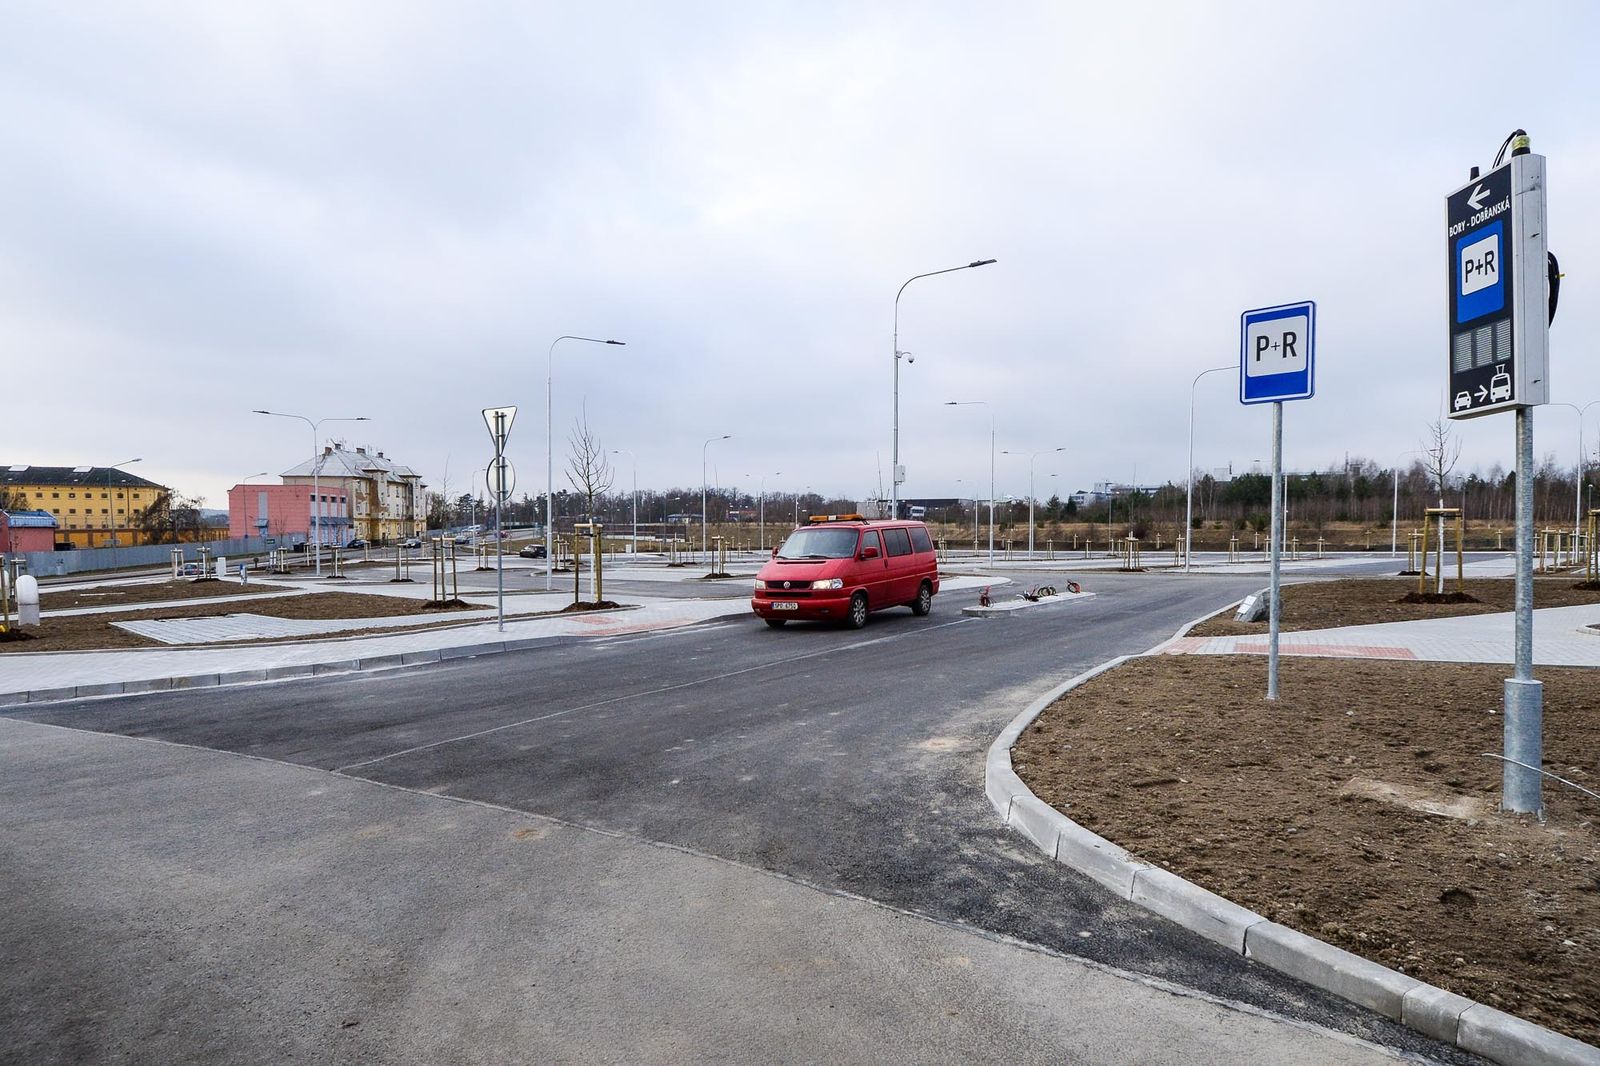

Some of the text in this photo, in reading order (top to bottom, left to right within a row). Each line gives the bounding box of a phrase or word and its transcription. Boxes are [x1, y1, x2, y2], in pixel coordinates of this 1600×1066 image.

[1449, 220, 1465, 237] BORY
[1471, 195, 1510, 227] DOBŘANSKÁ
[1465, 250, 1495, 283] P+R
[1256, 331, 1297, 361] P+R
